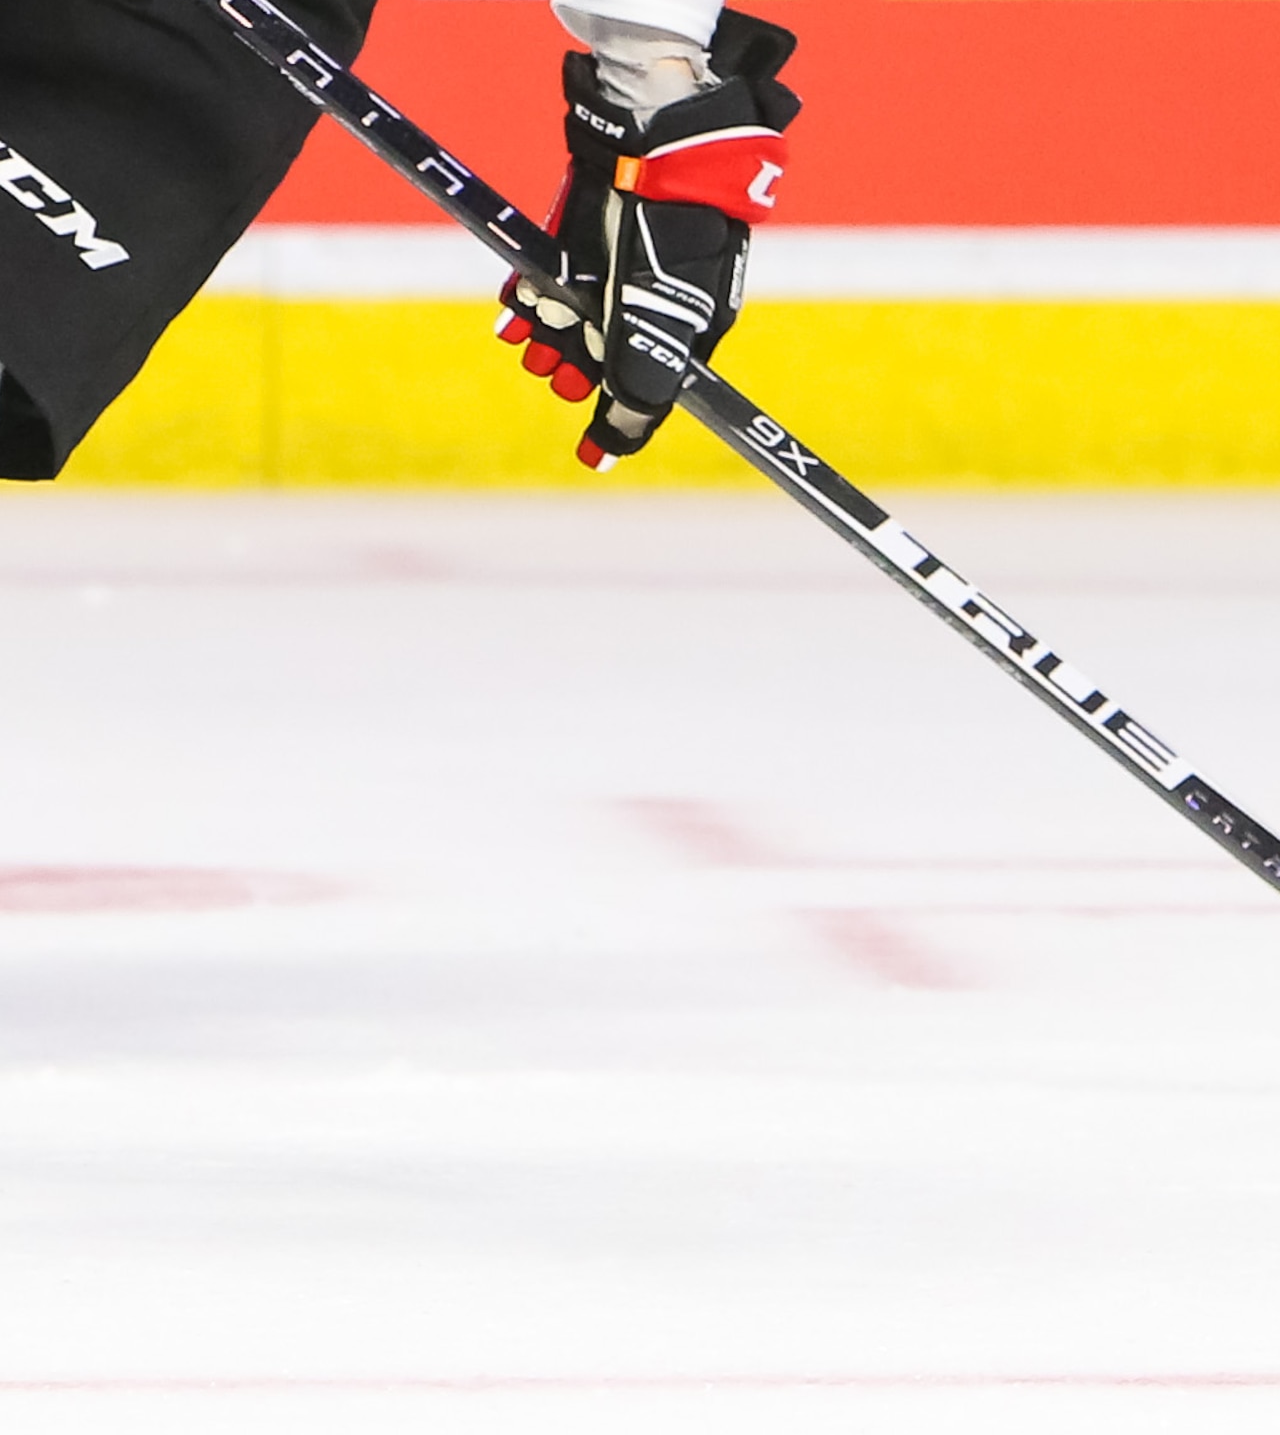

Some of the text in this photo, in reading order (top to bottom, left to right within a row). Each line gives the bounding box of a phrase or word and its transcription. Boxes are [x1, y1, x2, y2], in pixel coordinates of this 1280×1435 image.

[574, 103, 626, 140] CCM
[628, 331, 686, 373] CCM
[746, 414, 820, 476] 9X
[900, 529, 1179, 772] TRUE
